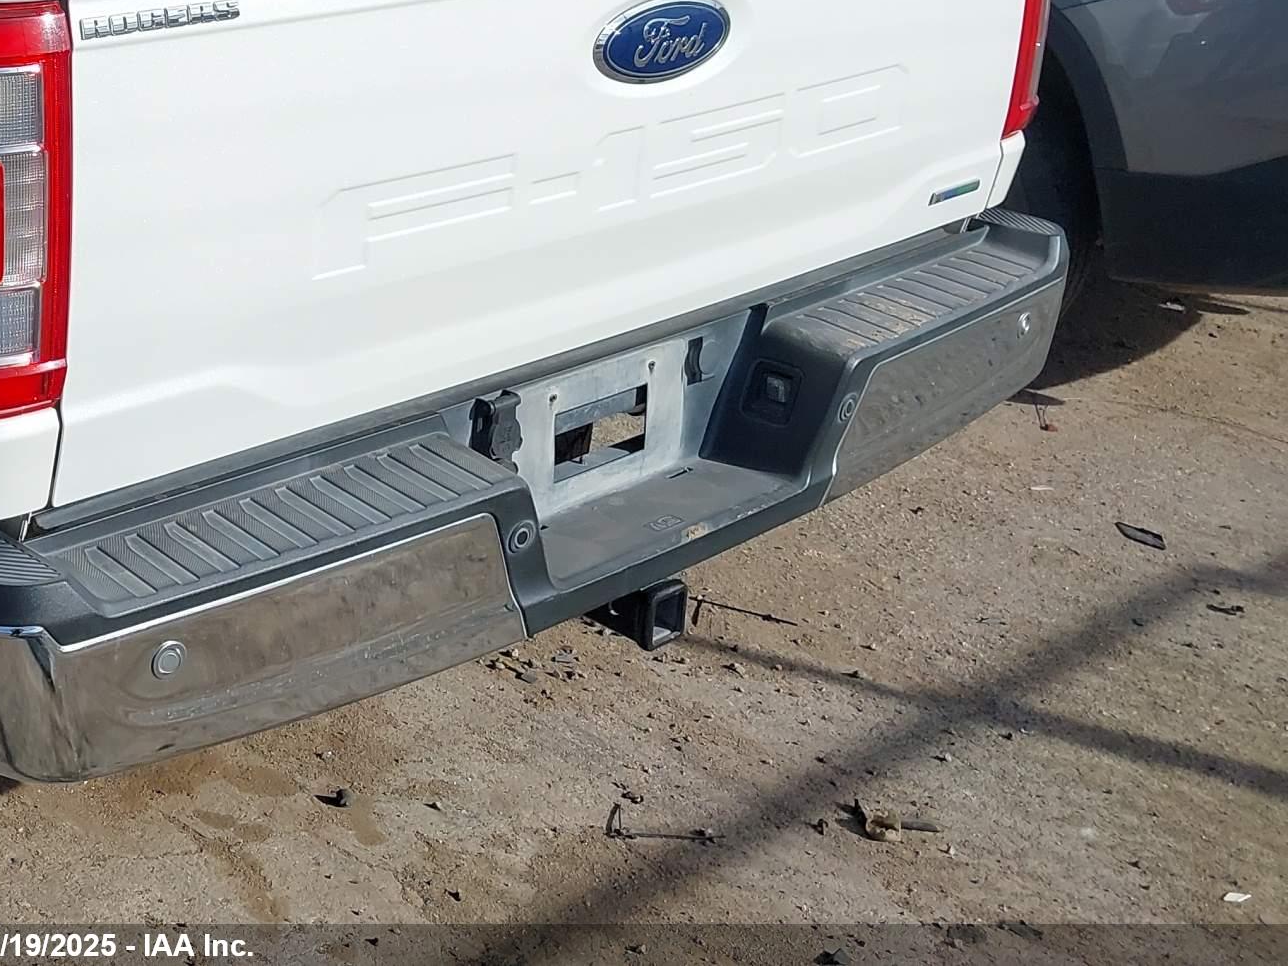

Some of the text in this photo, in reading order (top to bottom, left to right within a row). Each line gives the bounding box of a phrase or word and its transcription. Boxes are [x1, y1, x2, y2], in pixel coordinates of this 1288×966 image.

[80, 0, 240, 40] ROGERS
[634, 15, 707, 67] Ford
[312, 64, 909, 280] F-150
